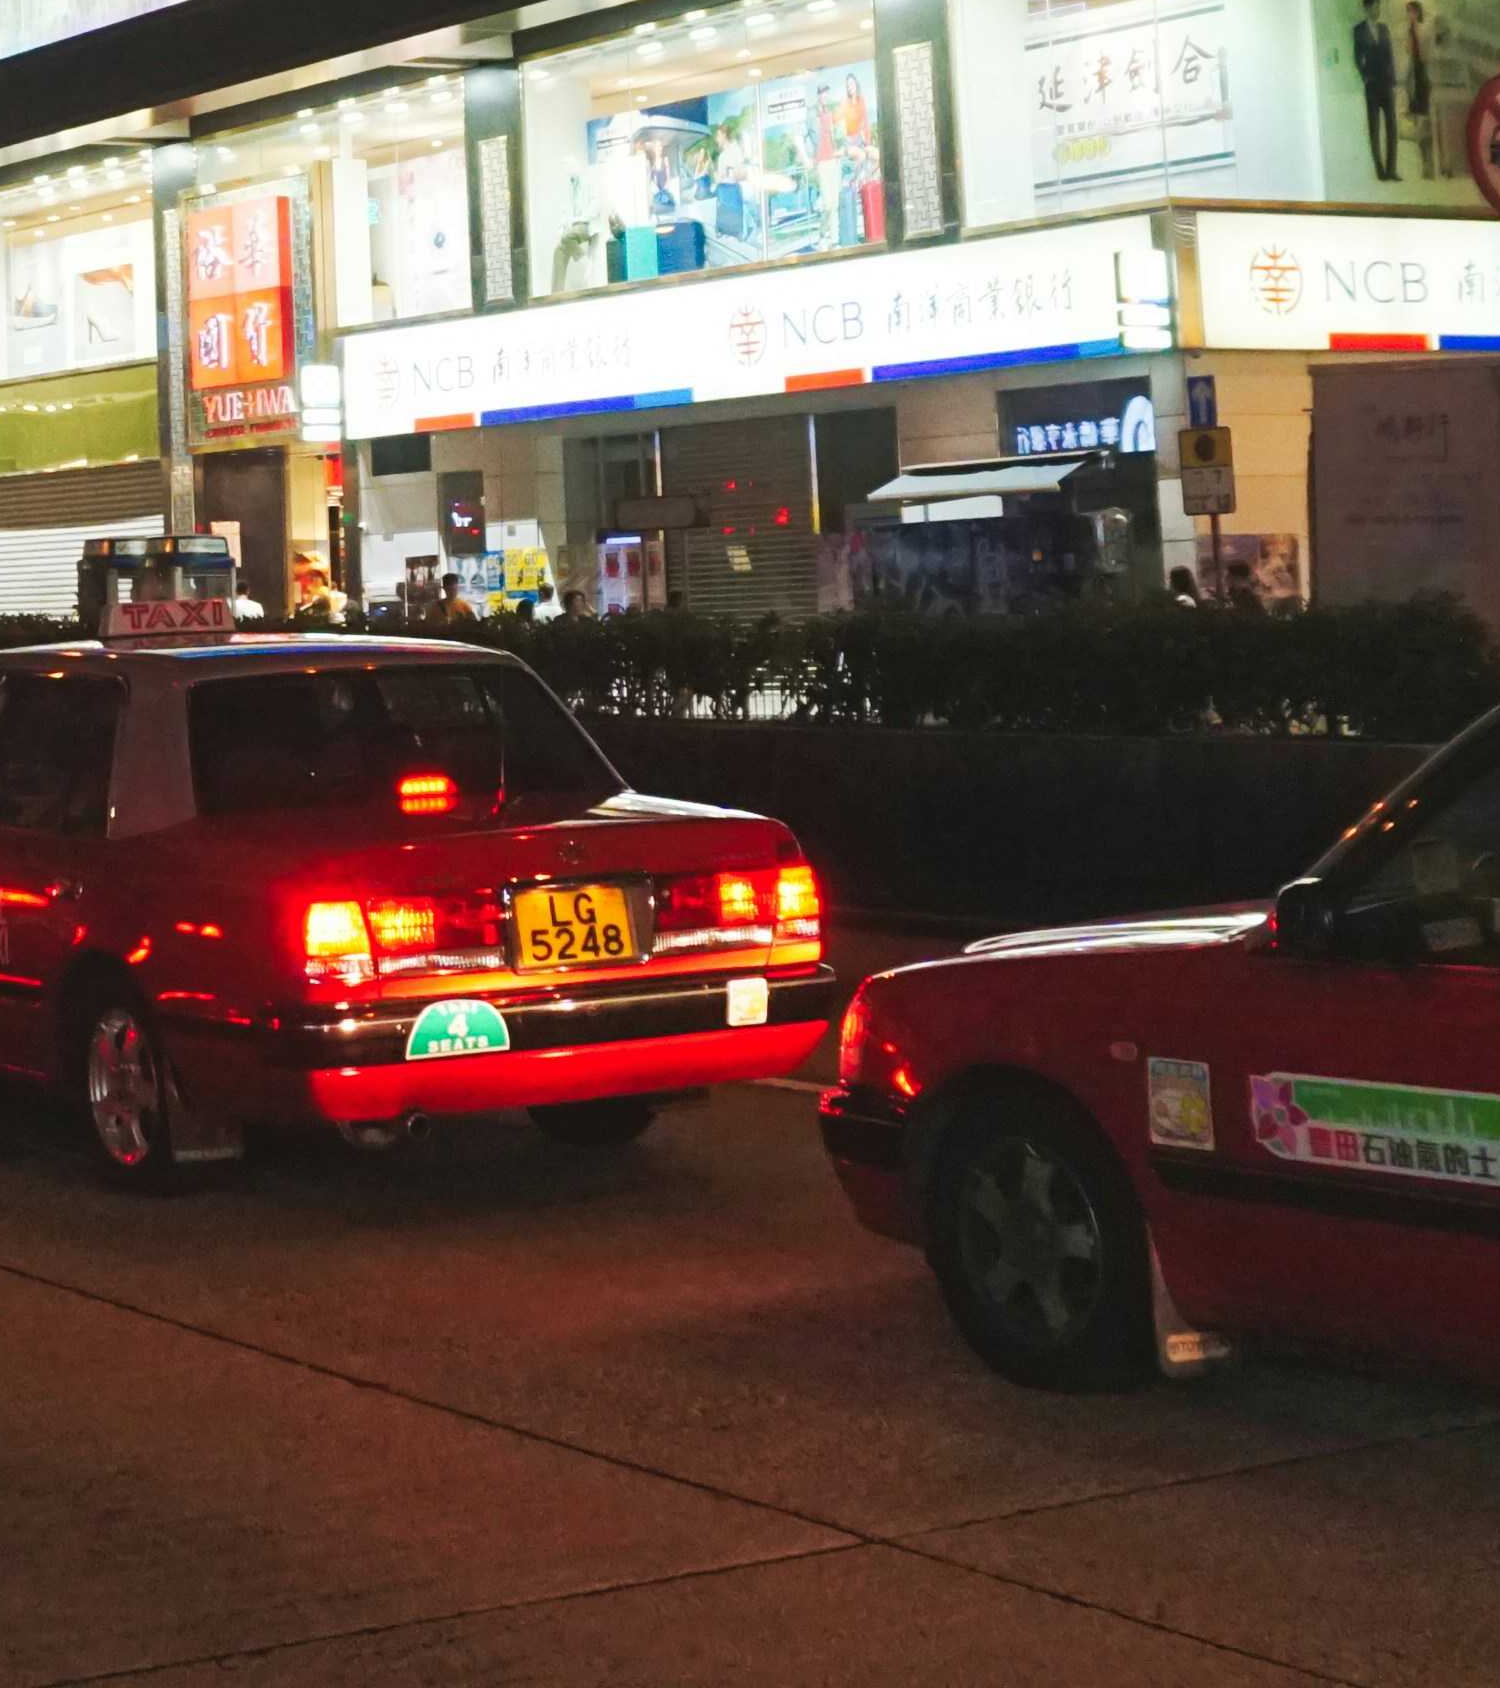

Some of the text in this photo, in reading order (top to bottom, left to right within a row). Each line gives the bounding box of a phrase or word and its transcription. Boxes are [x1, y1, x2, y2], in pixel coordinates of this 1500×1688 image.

[1322, 259, 1429, 304] NCB
[782, 302, 865, 346] NCB
[411, 357, 475, 394] NCB
[202, 385, 297, 424] YUE HWA
[120, 601, 224, 630] TAXI
[549, 892, 598, 928] LG
[530, 923, 625, 962] 5248
[447, 1013, 469, 1038] 4
[427, 1035, 489, 1054] SEATS
